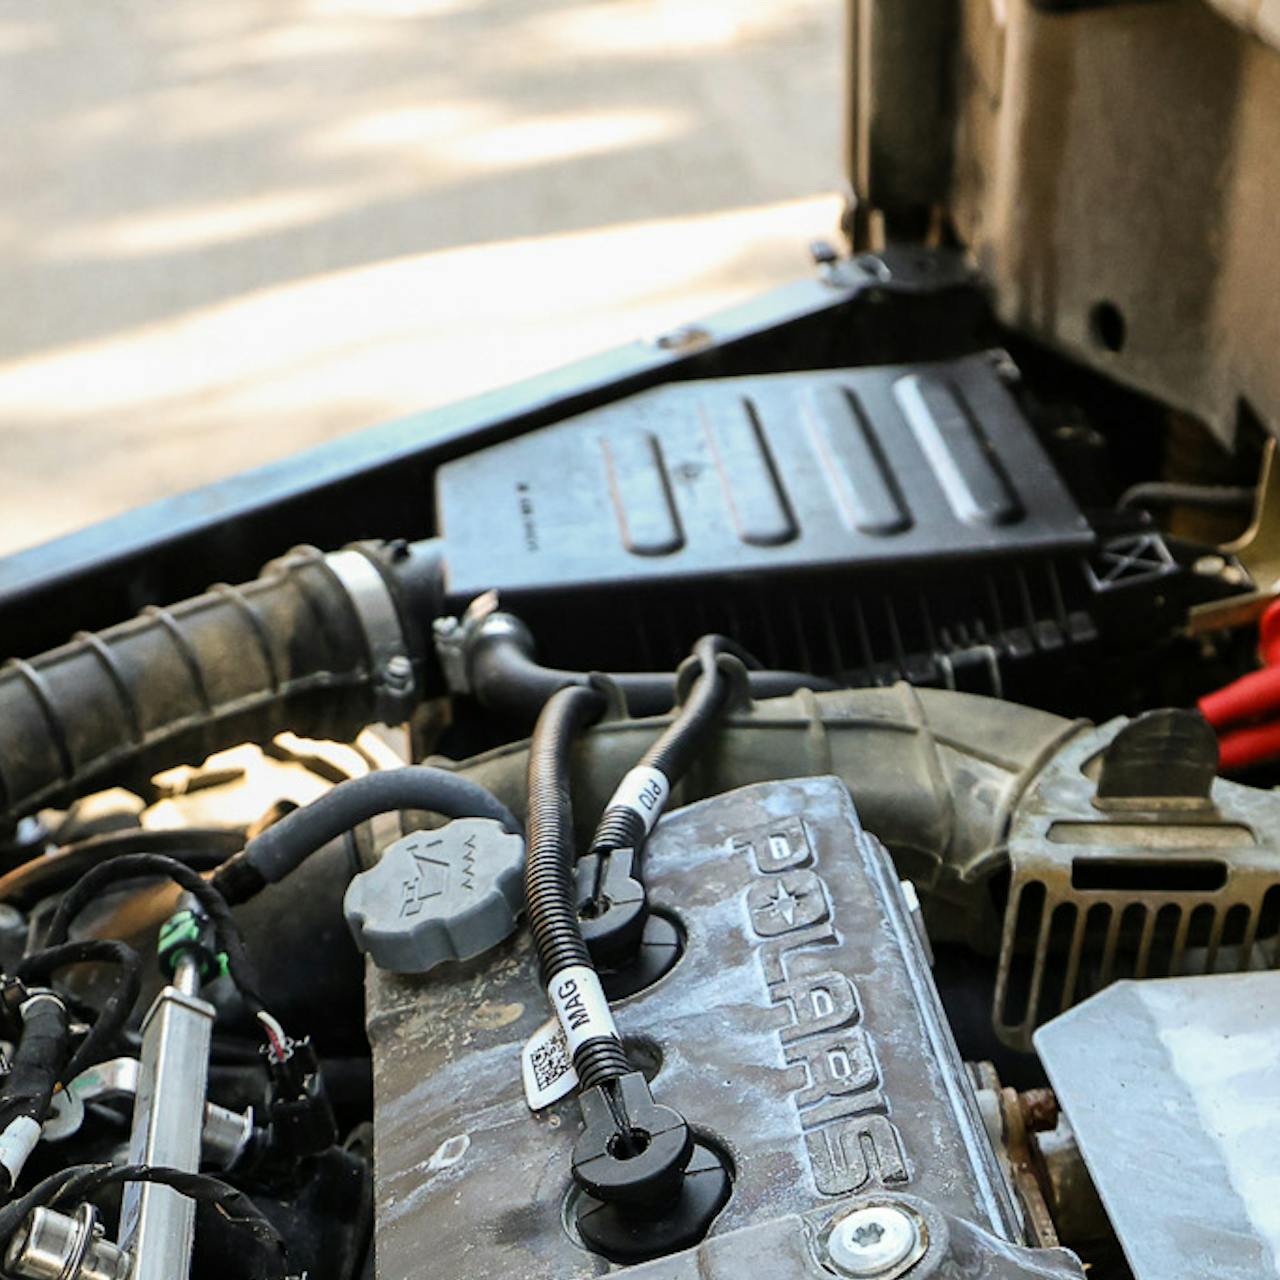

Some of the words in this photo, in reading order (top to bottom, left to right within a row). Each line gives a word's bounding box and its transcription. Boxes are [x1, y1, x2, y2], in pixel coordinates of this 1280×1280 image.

[638, 778, 662, 811] PTO
[558, 978, 591, 1031] MAG
[730, 815, 910, 1197] POLARIS
